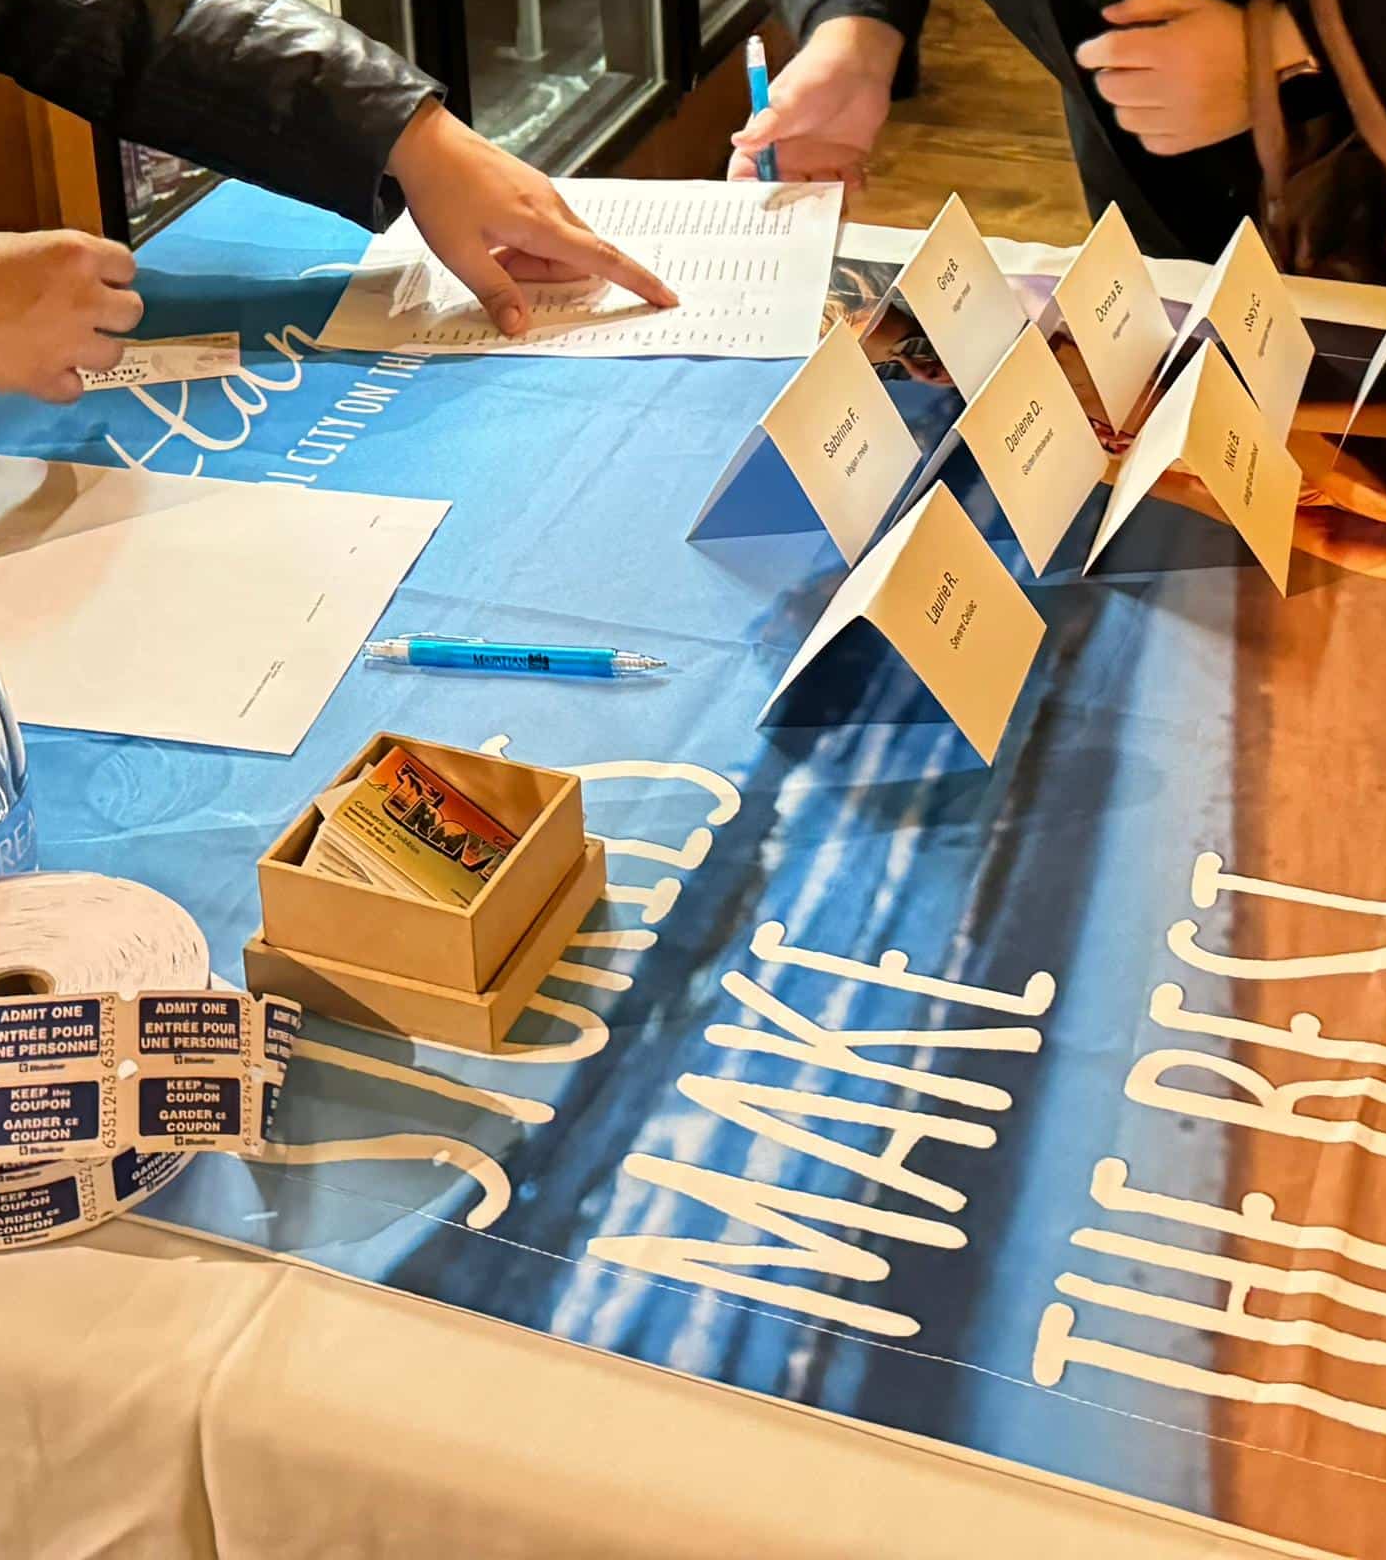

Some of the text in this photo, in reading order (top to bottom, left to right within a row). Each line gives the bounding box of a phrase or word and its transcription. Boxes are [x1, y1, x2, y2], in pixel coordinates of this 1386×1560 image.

[936, 267, 955, 290] Greg
[1095, 290, 1117, 323] Donna
[286, 416, 366, 465] CITY
[335, 382, 400, 415] ON
[1004, 400, 1043, 453] Darlene D.
[823, 407, 860, 459] Sabrina F.
[925, 571, 960, 625] Laurie R.
[354, 799, 392, 832] Catherine
[0, 1006, 83, 1023] ADMIT ONE
[155, 1003, 228, 1015] ADMIT ONE
[52, 1025, 94, 1038] POUR
[100, 995, 115, 1069] 6351243
[145, 1020, 236, 1034] ENTRÉE POUR
[19, 1040, 98, 1056] PERSONNE
[141, 1037, 240, 1049] UNE PERSONNE
[166, 1080, 202, 1090] KEEP
[11, 1088, 48, 1100] KEEP
[166, 1093, 220, 1103] COUPON
[10, 1099, 71, 1112] COUPON
[101, 1075, 117, 1148] 6351243
[159, 1109, 213, 1120] GARDER
[3, 1117, 61, 1131] GARDER
[166, 1122, 221, 1132] COUPON
[585, 920, 1057, 1338] MAKE
[10, 1129, 71, 1142] COUPON
[78, 1165, 98, 1221] 6351252
